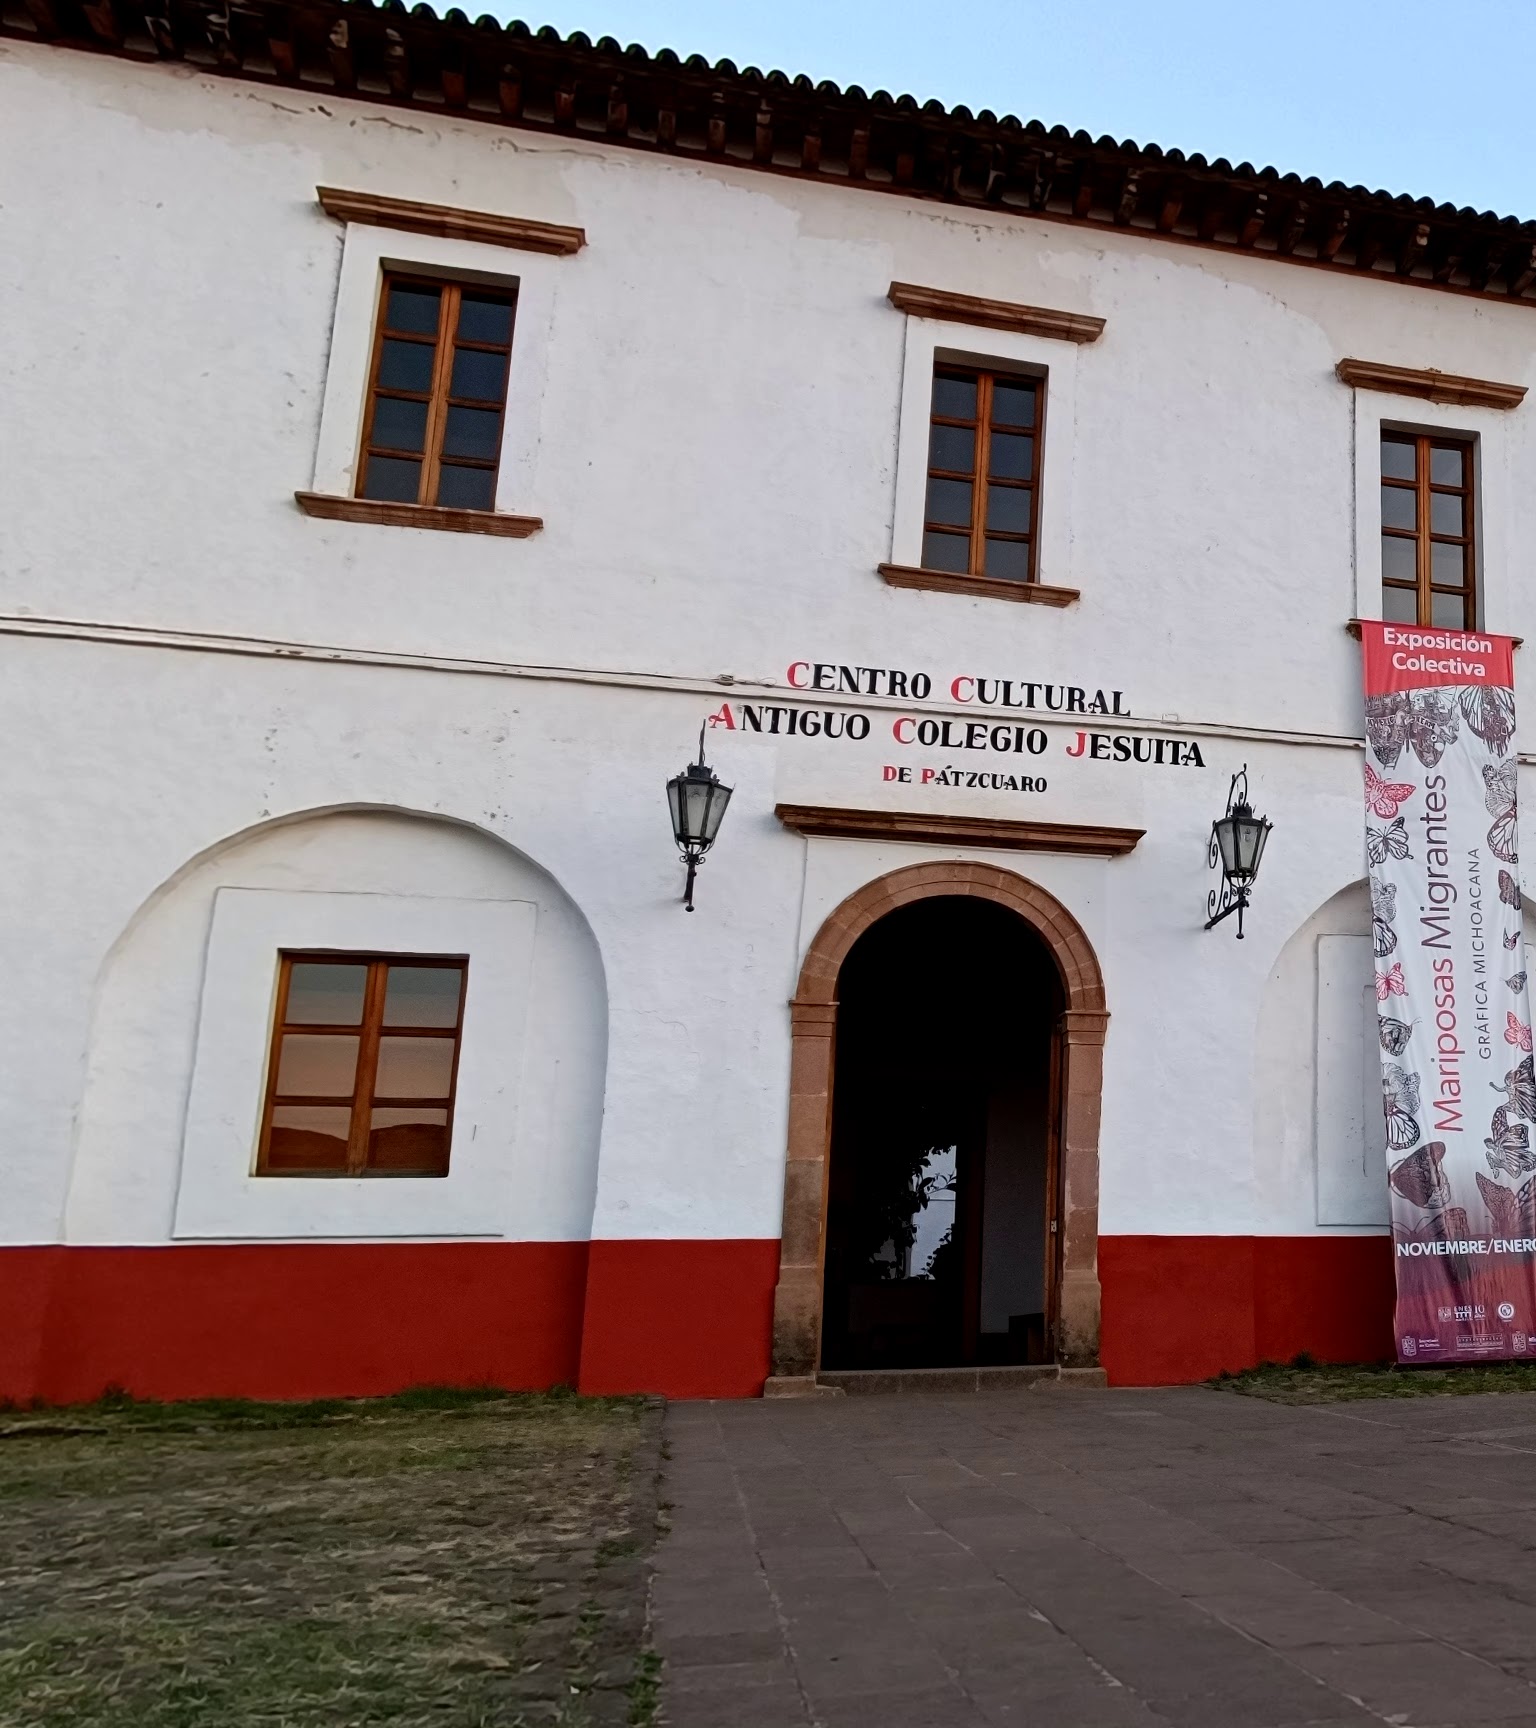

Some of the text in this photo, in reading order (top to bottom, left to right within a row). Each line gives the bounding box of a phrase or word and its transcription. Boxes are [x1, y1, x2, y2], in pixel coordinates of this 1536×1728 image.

[1383, 627, 1493, 654] Exposición
[1392, 652, 1486, 677] Colectiva
[786, 660, 1131, 717] CENTRO CULTURAL
[708, 702, 1206, 767] ANTIGUO COLEGIO JESUITA
[882, 764, 1048, 793] DE PÁTZCUARO
[1419, 774, 1458, 950] Migrantes
[1466, 847, 1492, 1060] GRÁFICA MICHOACANA
[1430, 957, 1466, 1133] Mariposas
